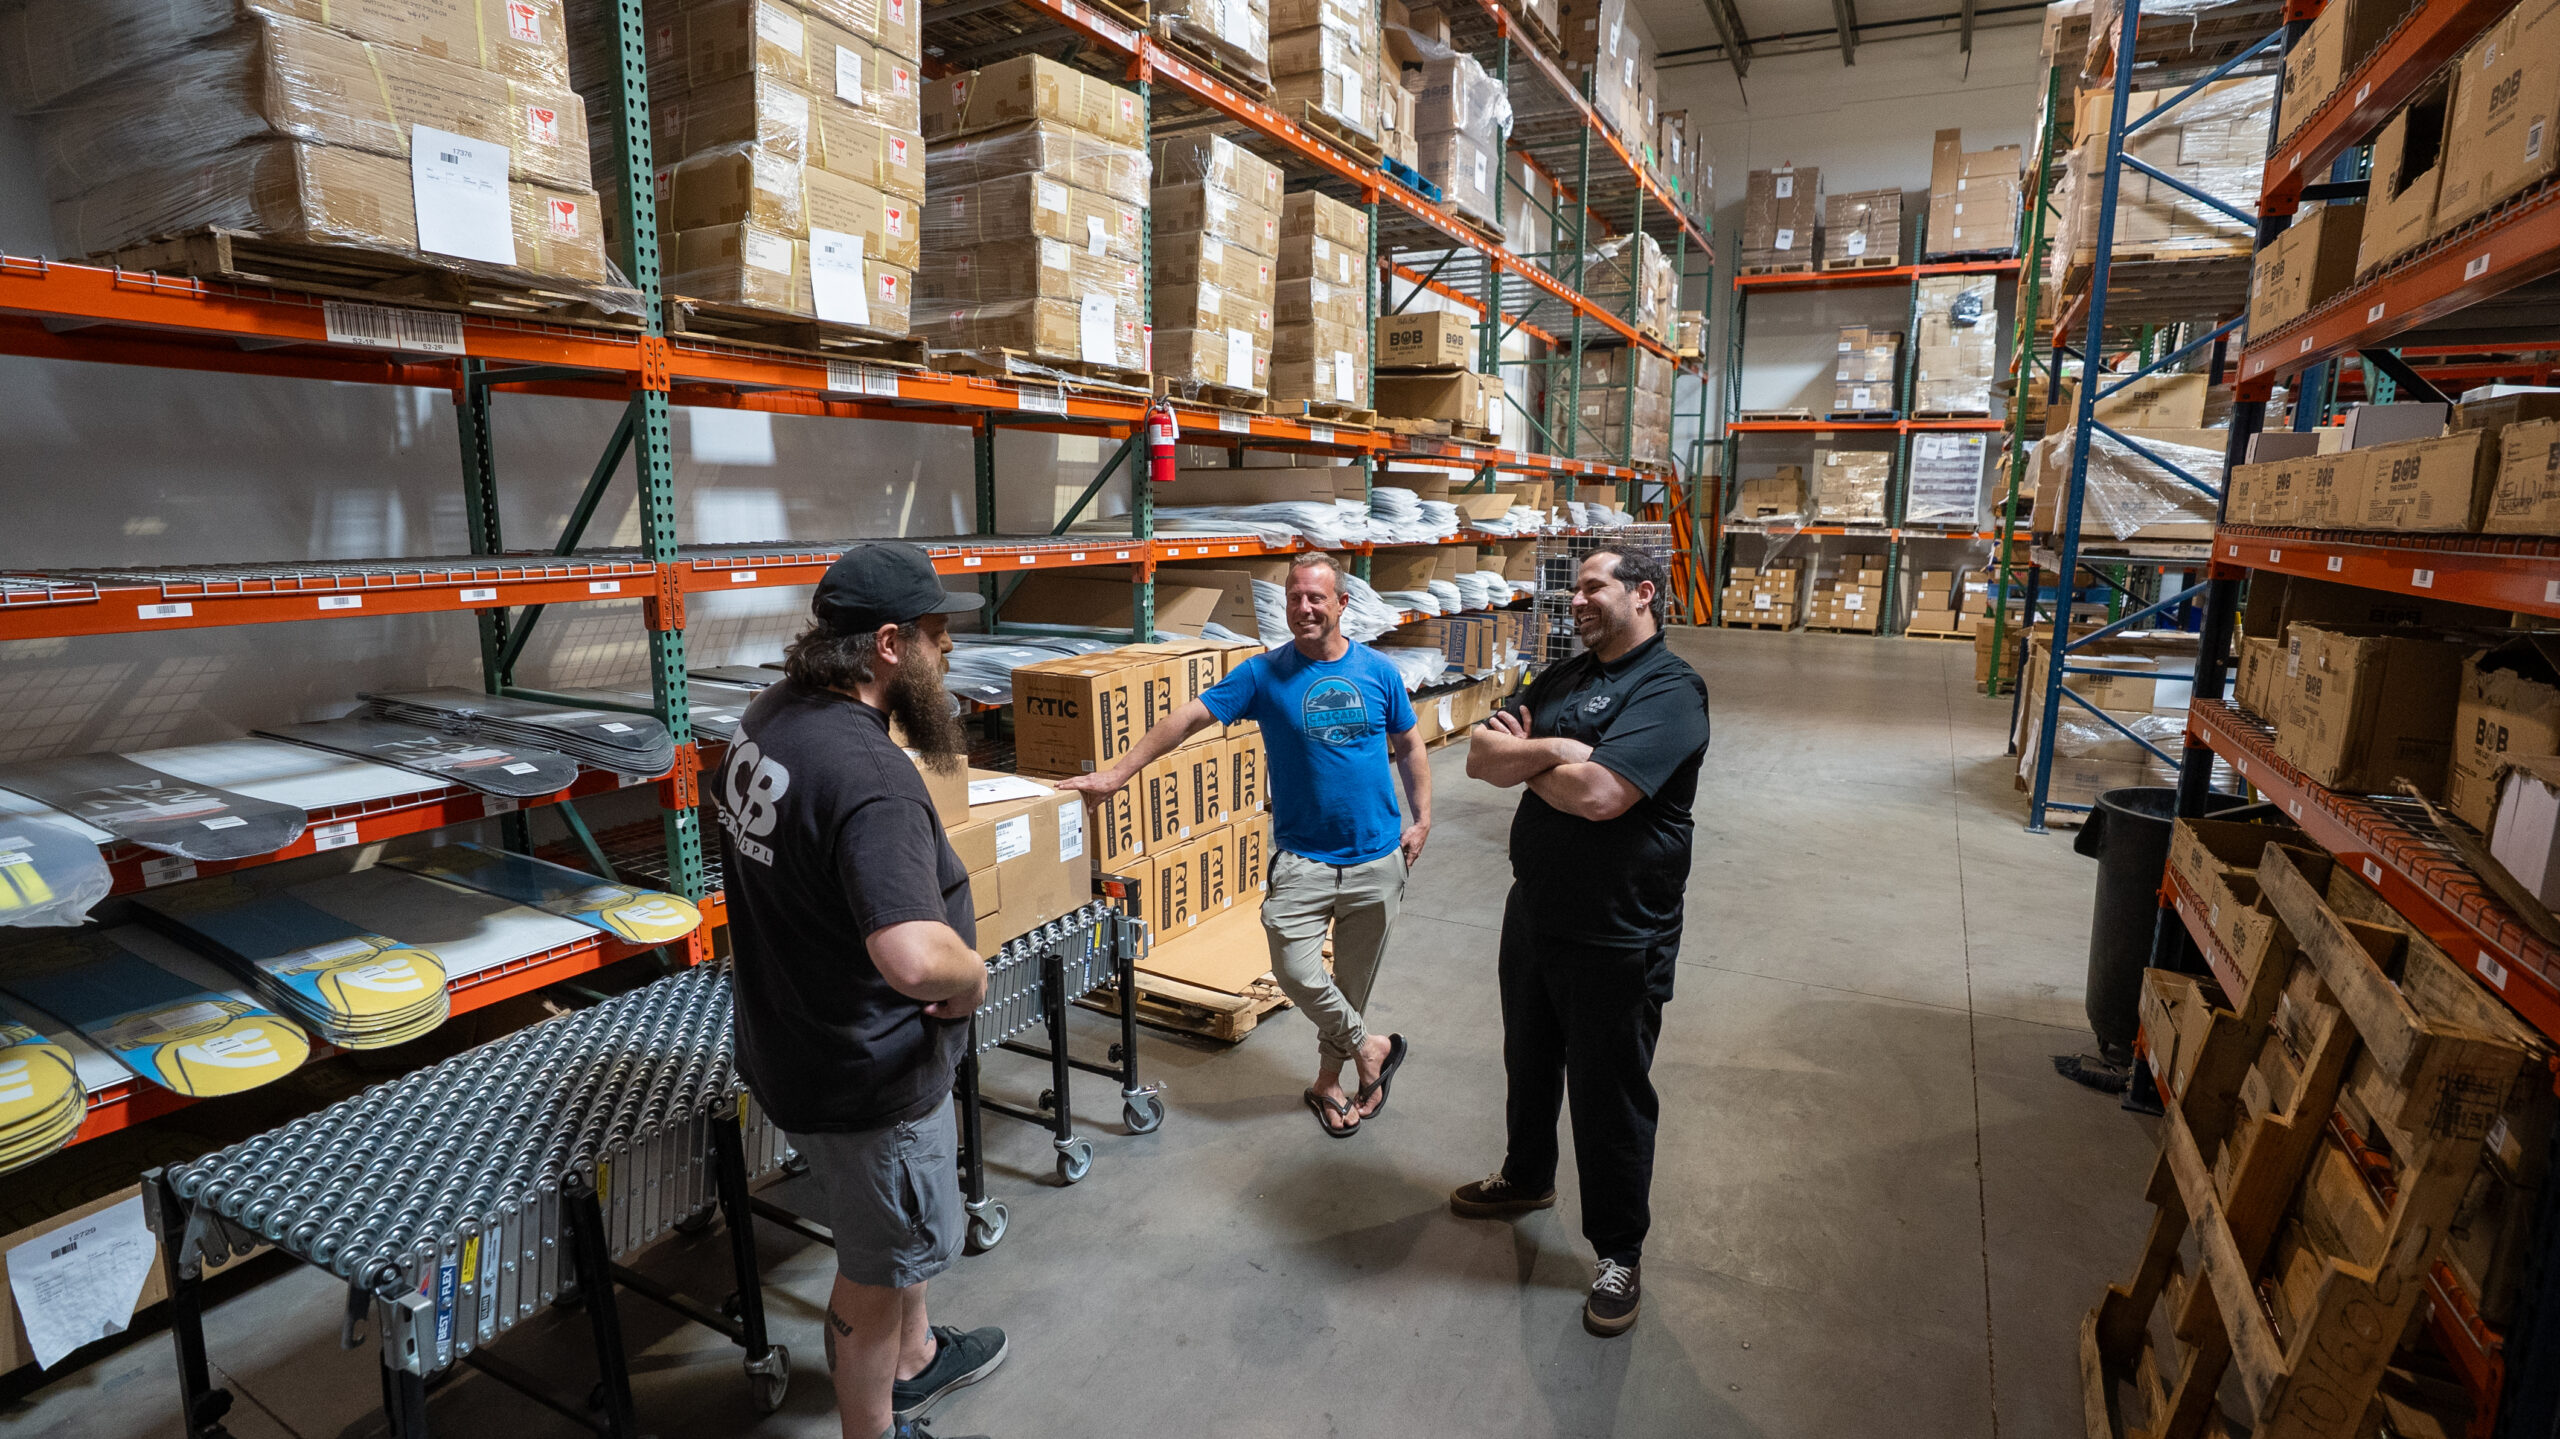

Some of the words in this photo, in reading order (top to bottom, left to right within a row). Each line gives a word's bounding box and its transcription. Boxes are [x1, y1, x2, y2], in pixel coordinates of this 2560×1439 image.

[2489, 68, 2521, 113] BOB
[1390, 330, 1423, 346] BOB
[1446, 333, 1463, 345] BOB
[2392, 456, 2421, 483] BOB
[1455, 623, 1463, 662] FRAGILE
[1027, 696, 1079, 719] RTIC
[1159, 677, 1171, 718] RT
[1115, 686, 1130, 754] RTIC
[2476, 717, 2509, 753] BOB
[726, 724, 790, 836] CB
[1206, 757, 1219, 819] RTIC
[1245, 748, 1255, 807] RTIC
[1119, 784, 1132, 851] RTIC
[1165, 771, 1179, 836] RTIC
[742, 842, 770, 861] 3PL
[1250, 830, 1259, 888] RTIC
[1176, 861, 1187, 924] RTIC
[1213, 845, 1223, 905] RTIC
[68, 1227, 96, 1241] 12729
[442, 1268, 452, 1297] FLEX
[481, 1295, 490, 1320] ULINE
[438, 1315, 448, 1341] BEST
